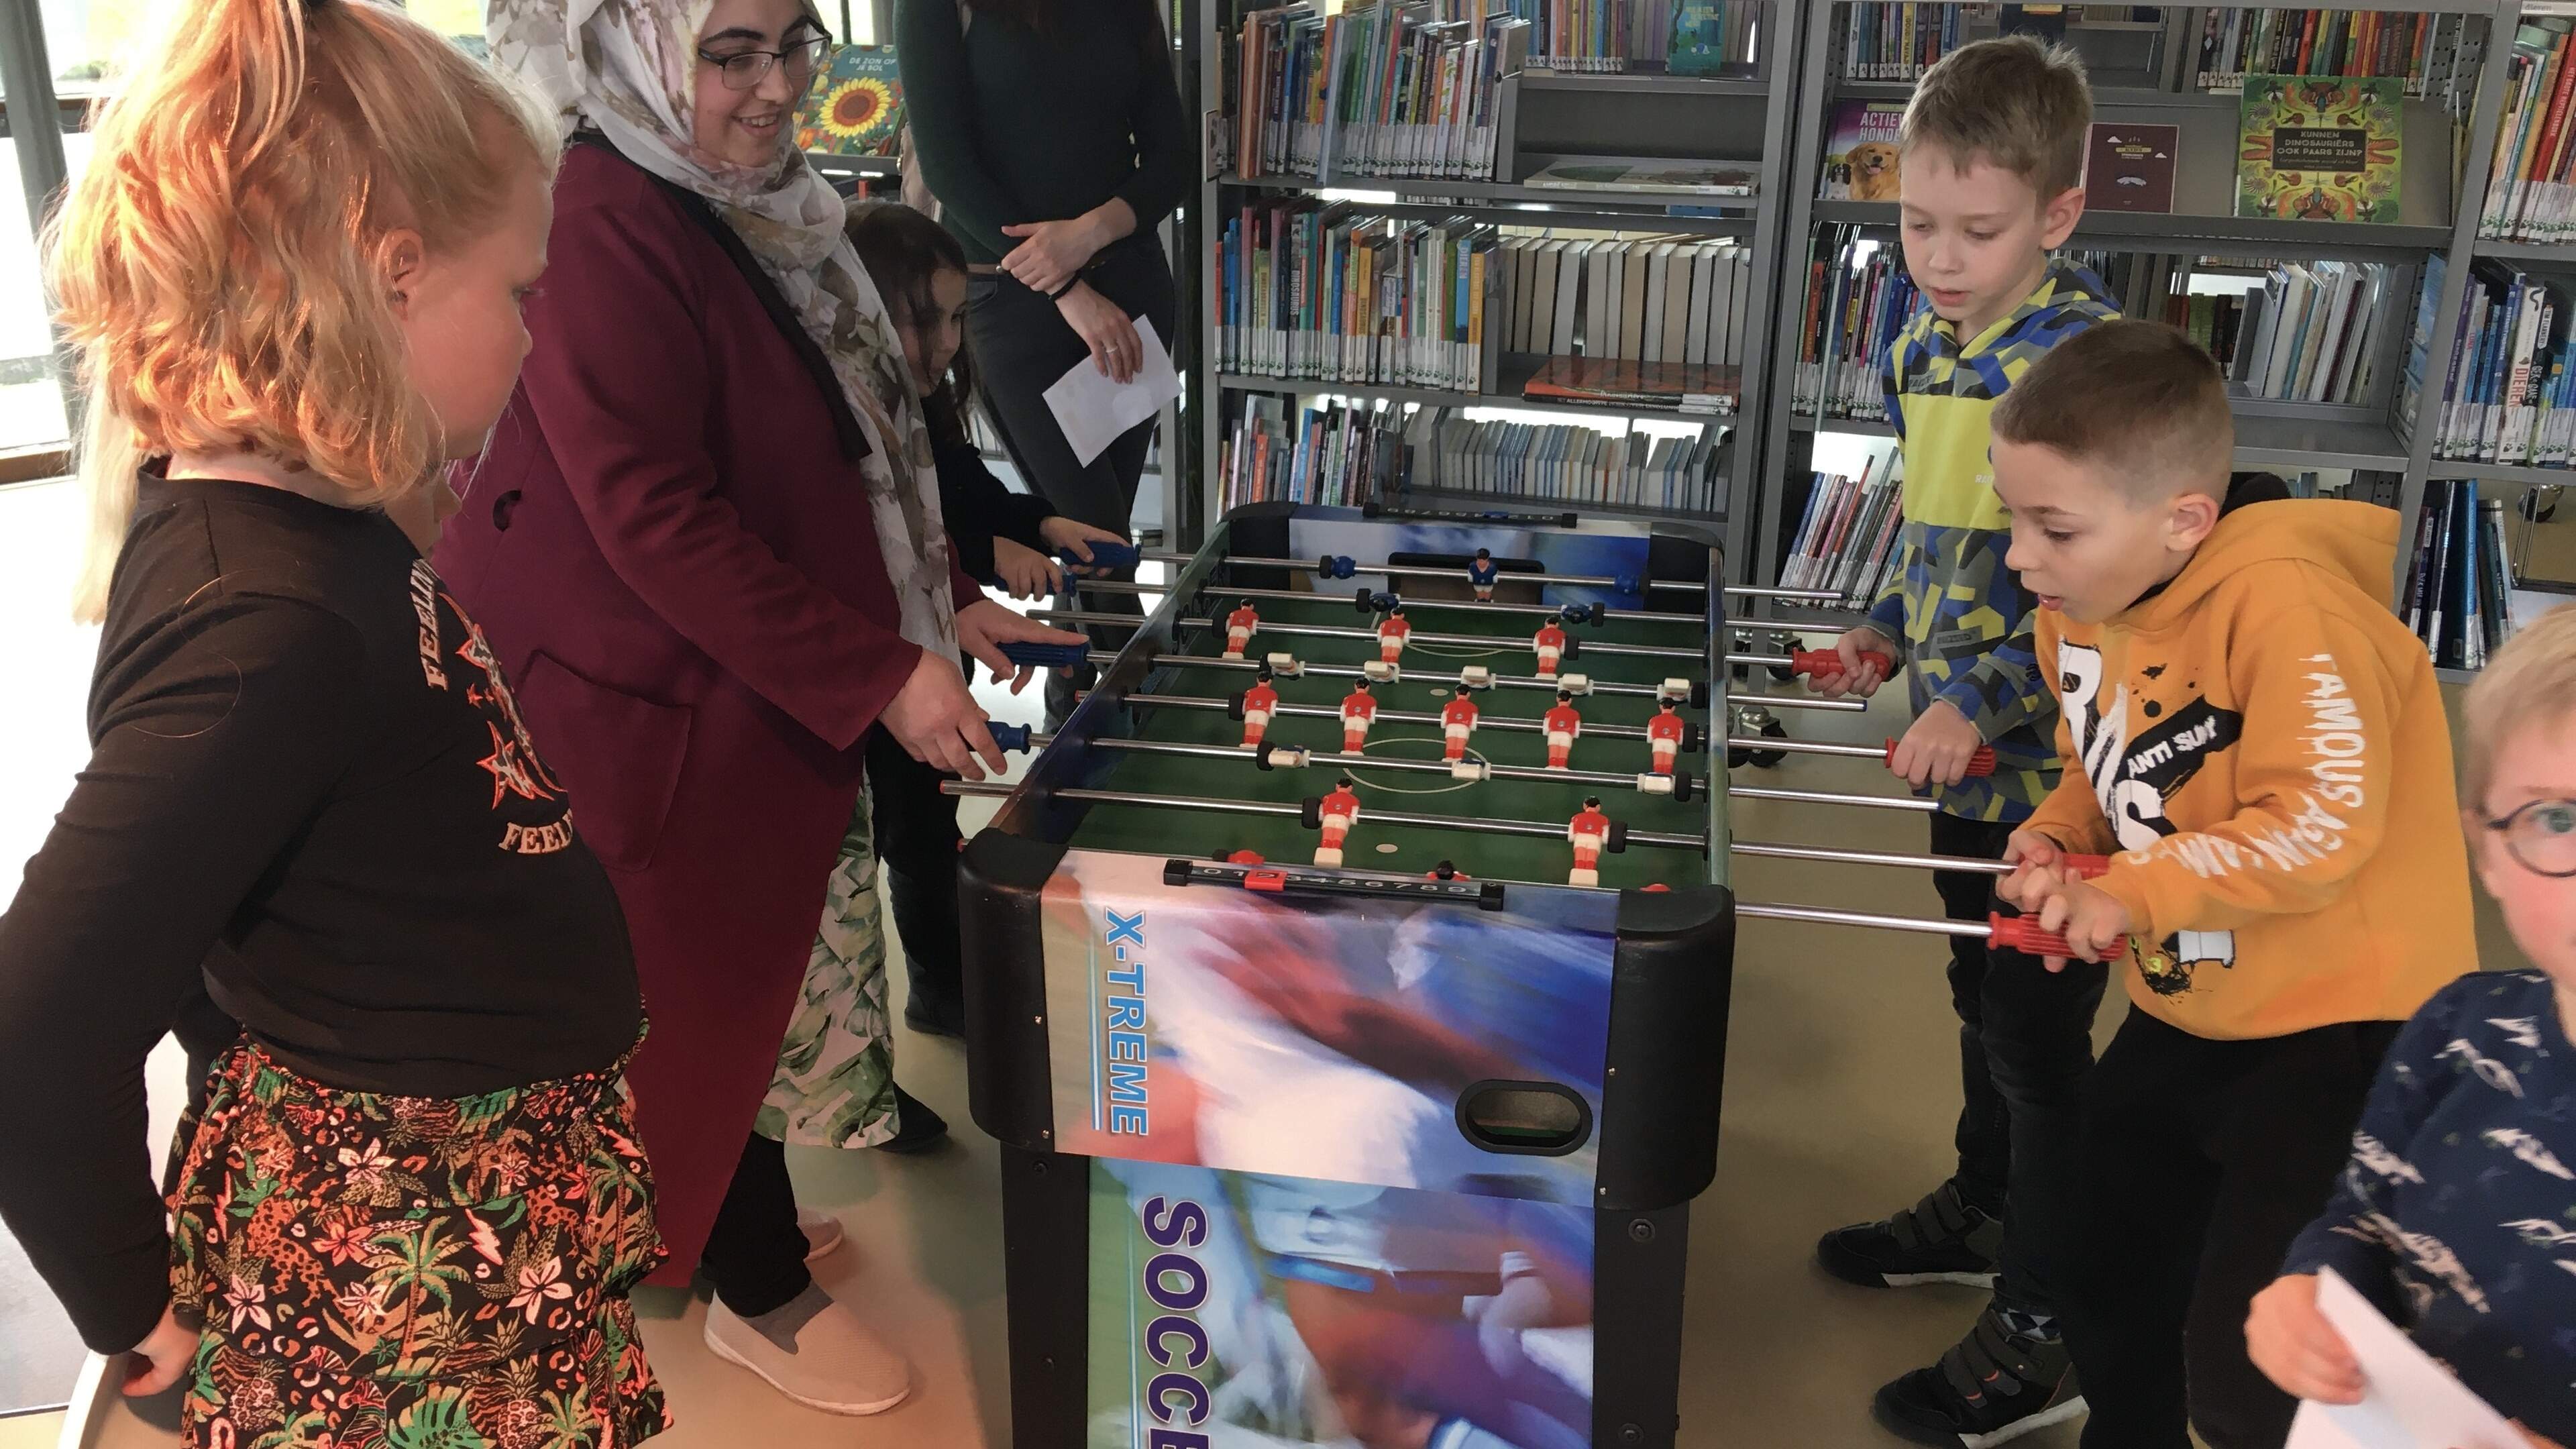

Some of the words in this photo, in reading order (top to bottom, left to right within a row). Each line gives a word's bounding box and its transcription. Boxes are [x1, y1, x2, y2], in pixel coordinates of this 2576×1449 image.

[2285, 139, 2355, 148] DINOSAURIËRS
[2303, 148, 2332, 156] PAARS
[1290, 270, 1301, 315] DINOSAURUS
[2508, 368, 2529, 409] DIEREN
[2126, 740, 2174, 779] ANTI
[1104, 908, 1150, 1136] X-TREME
